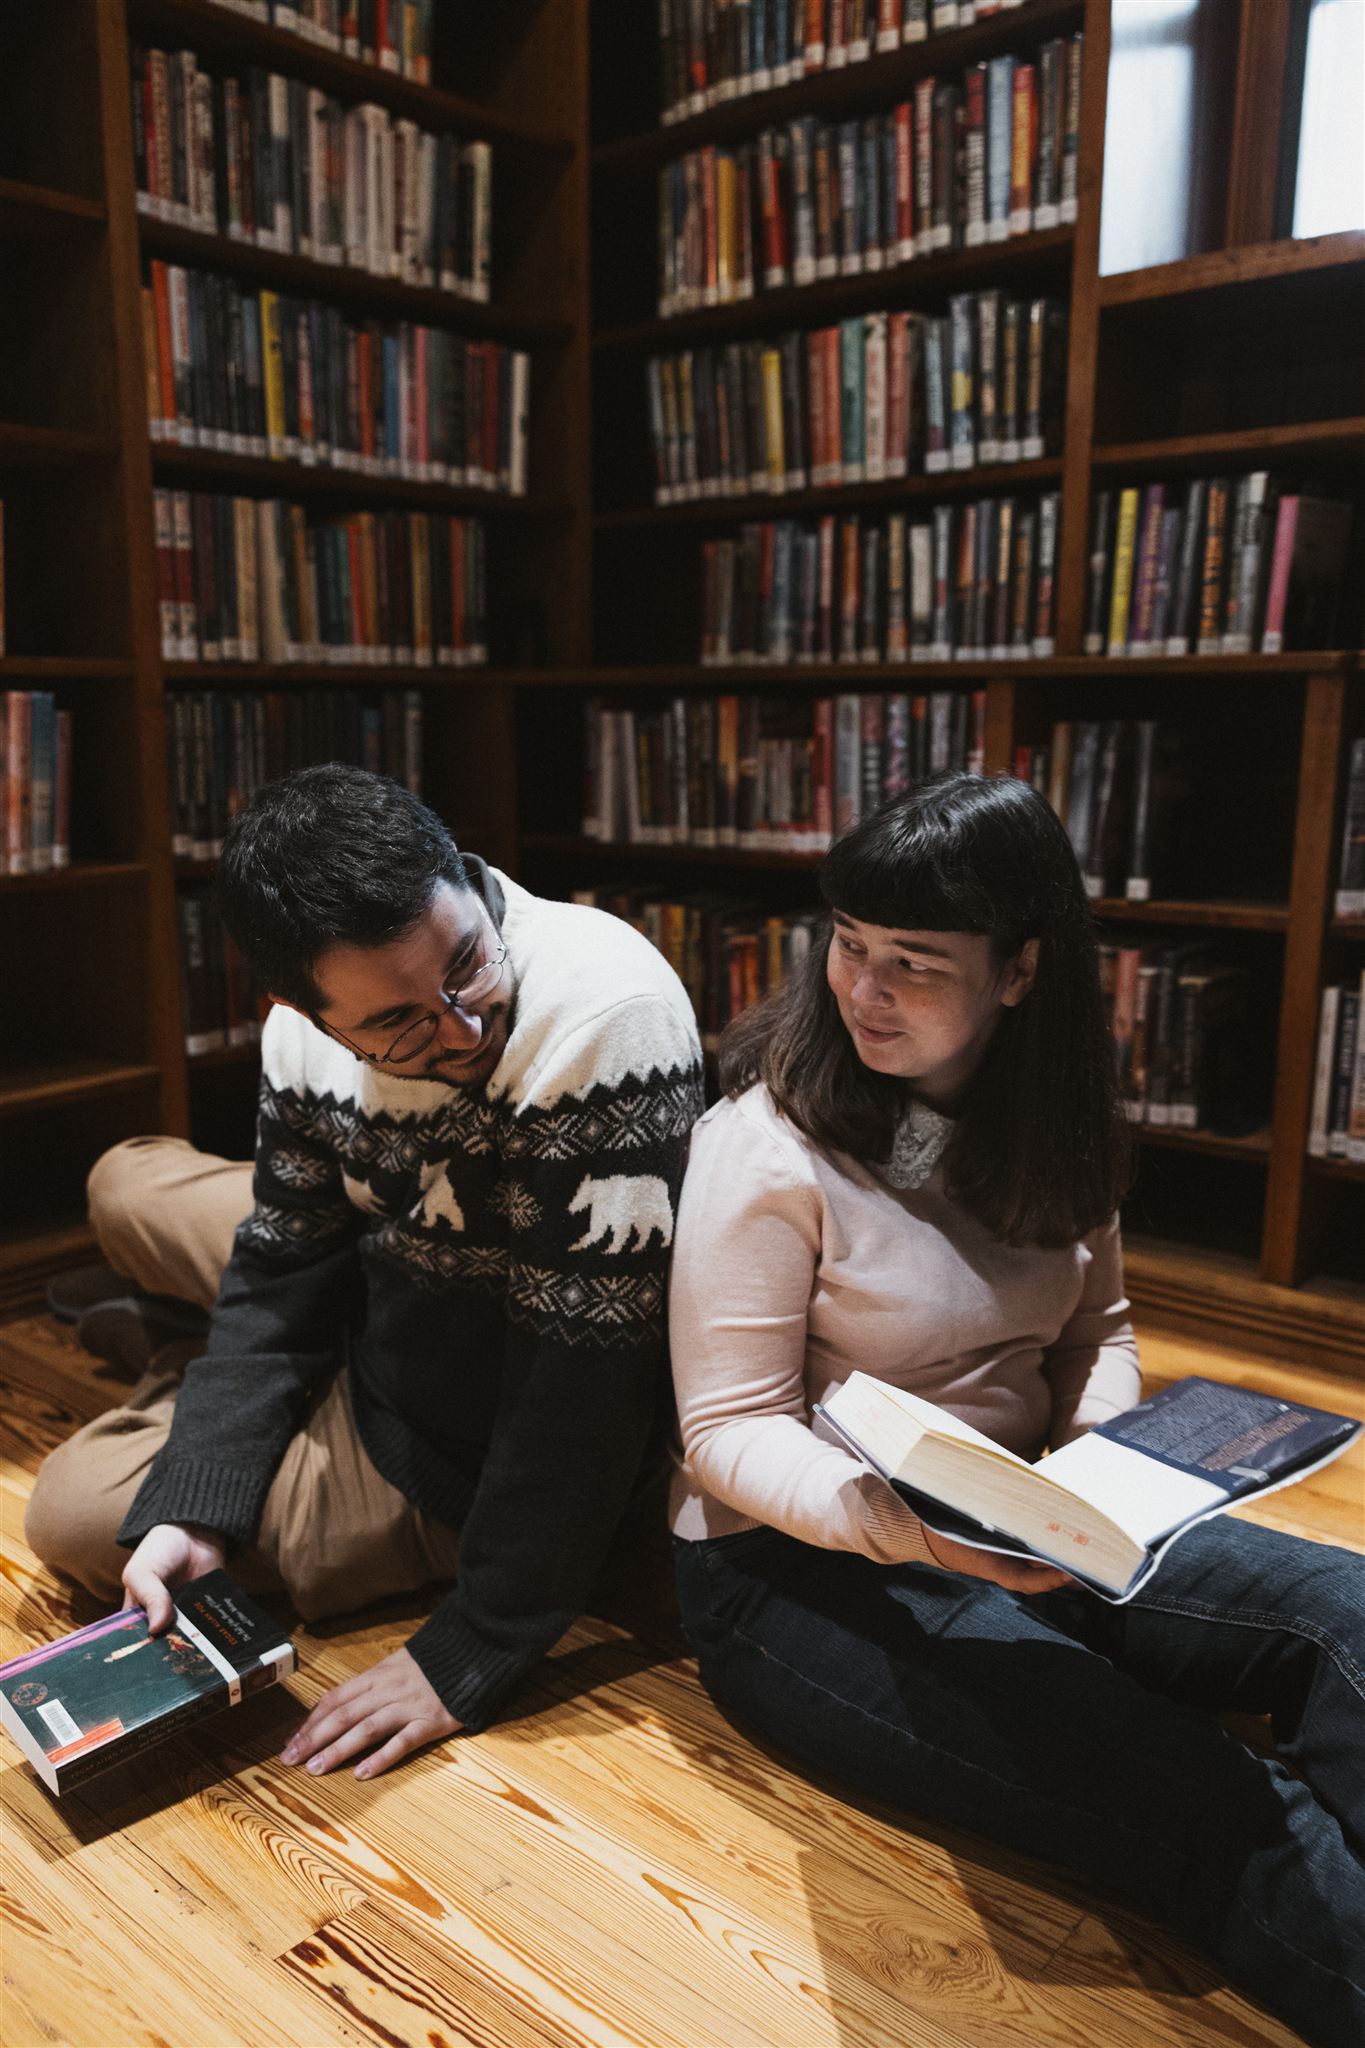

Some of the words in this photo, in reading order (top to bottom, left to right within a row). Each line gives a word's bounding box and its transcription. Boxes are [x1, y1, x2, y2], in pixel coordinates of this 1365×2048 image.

[194, 1602, 206, 1613] POE
[203, 1611, 221, 1628] ALLAN
[219, 1627, 238, 1645] EDGAR
